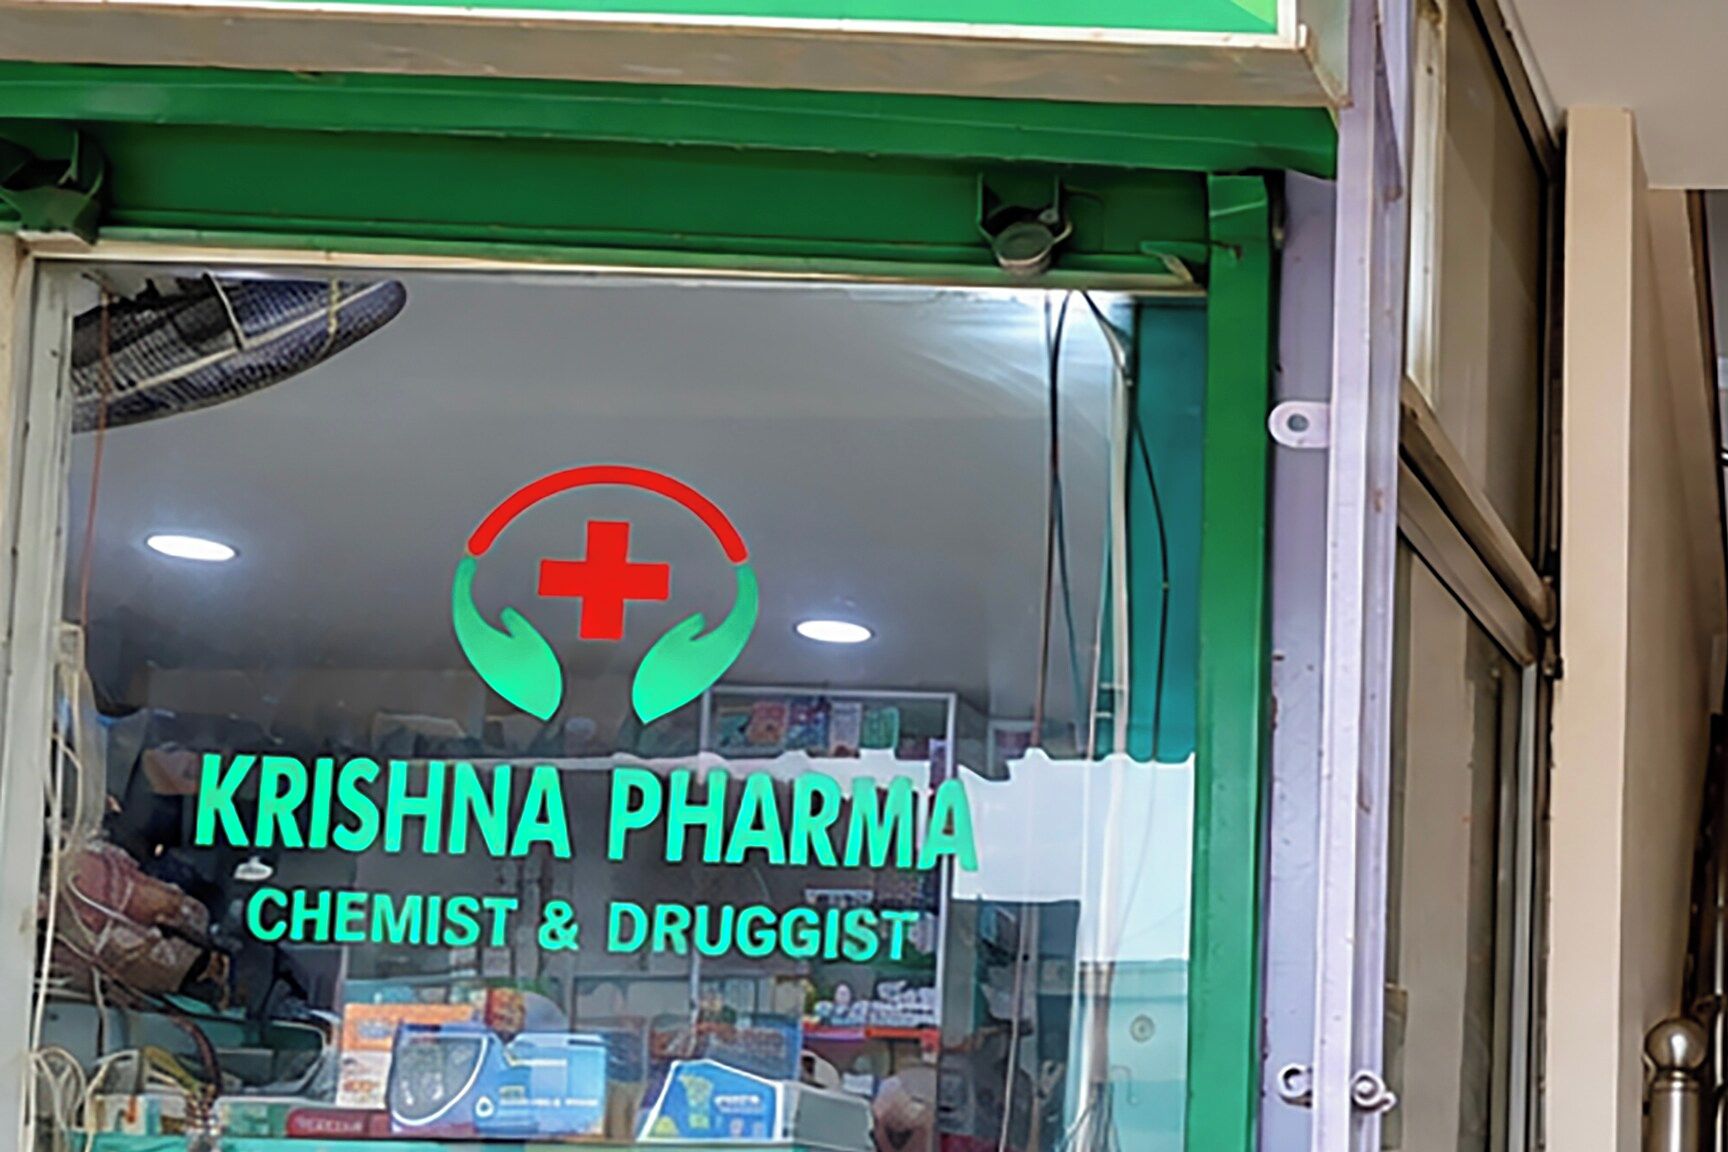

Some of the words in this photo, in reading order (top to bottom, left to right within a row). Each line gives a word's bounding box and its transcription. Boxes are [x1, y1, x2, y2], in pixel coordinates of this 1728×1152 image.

[194, 753, 572, 859] KRISHNA
[607, 767, 979, 872] PHARMA
[246, 887, 519, 947] CHEMIST
[537, 899, 580, 951] &
[607, 901, 921, 962] DRUGGIST
